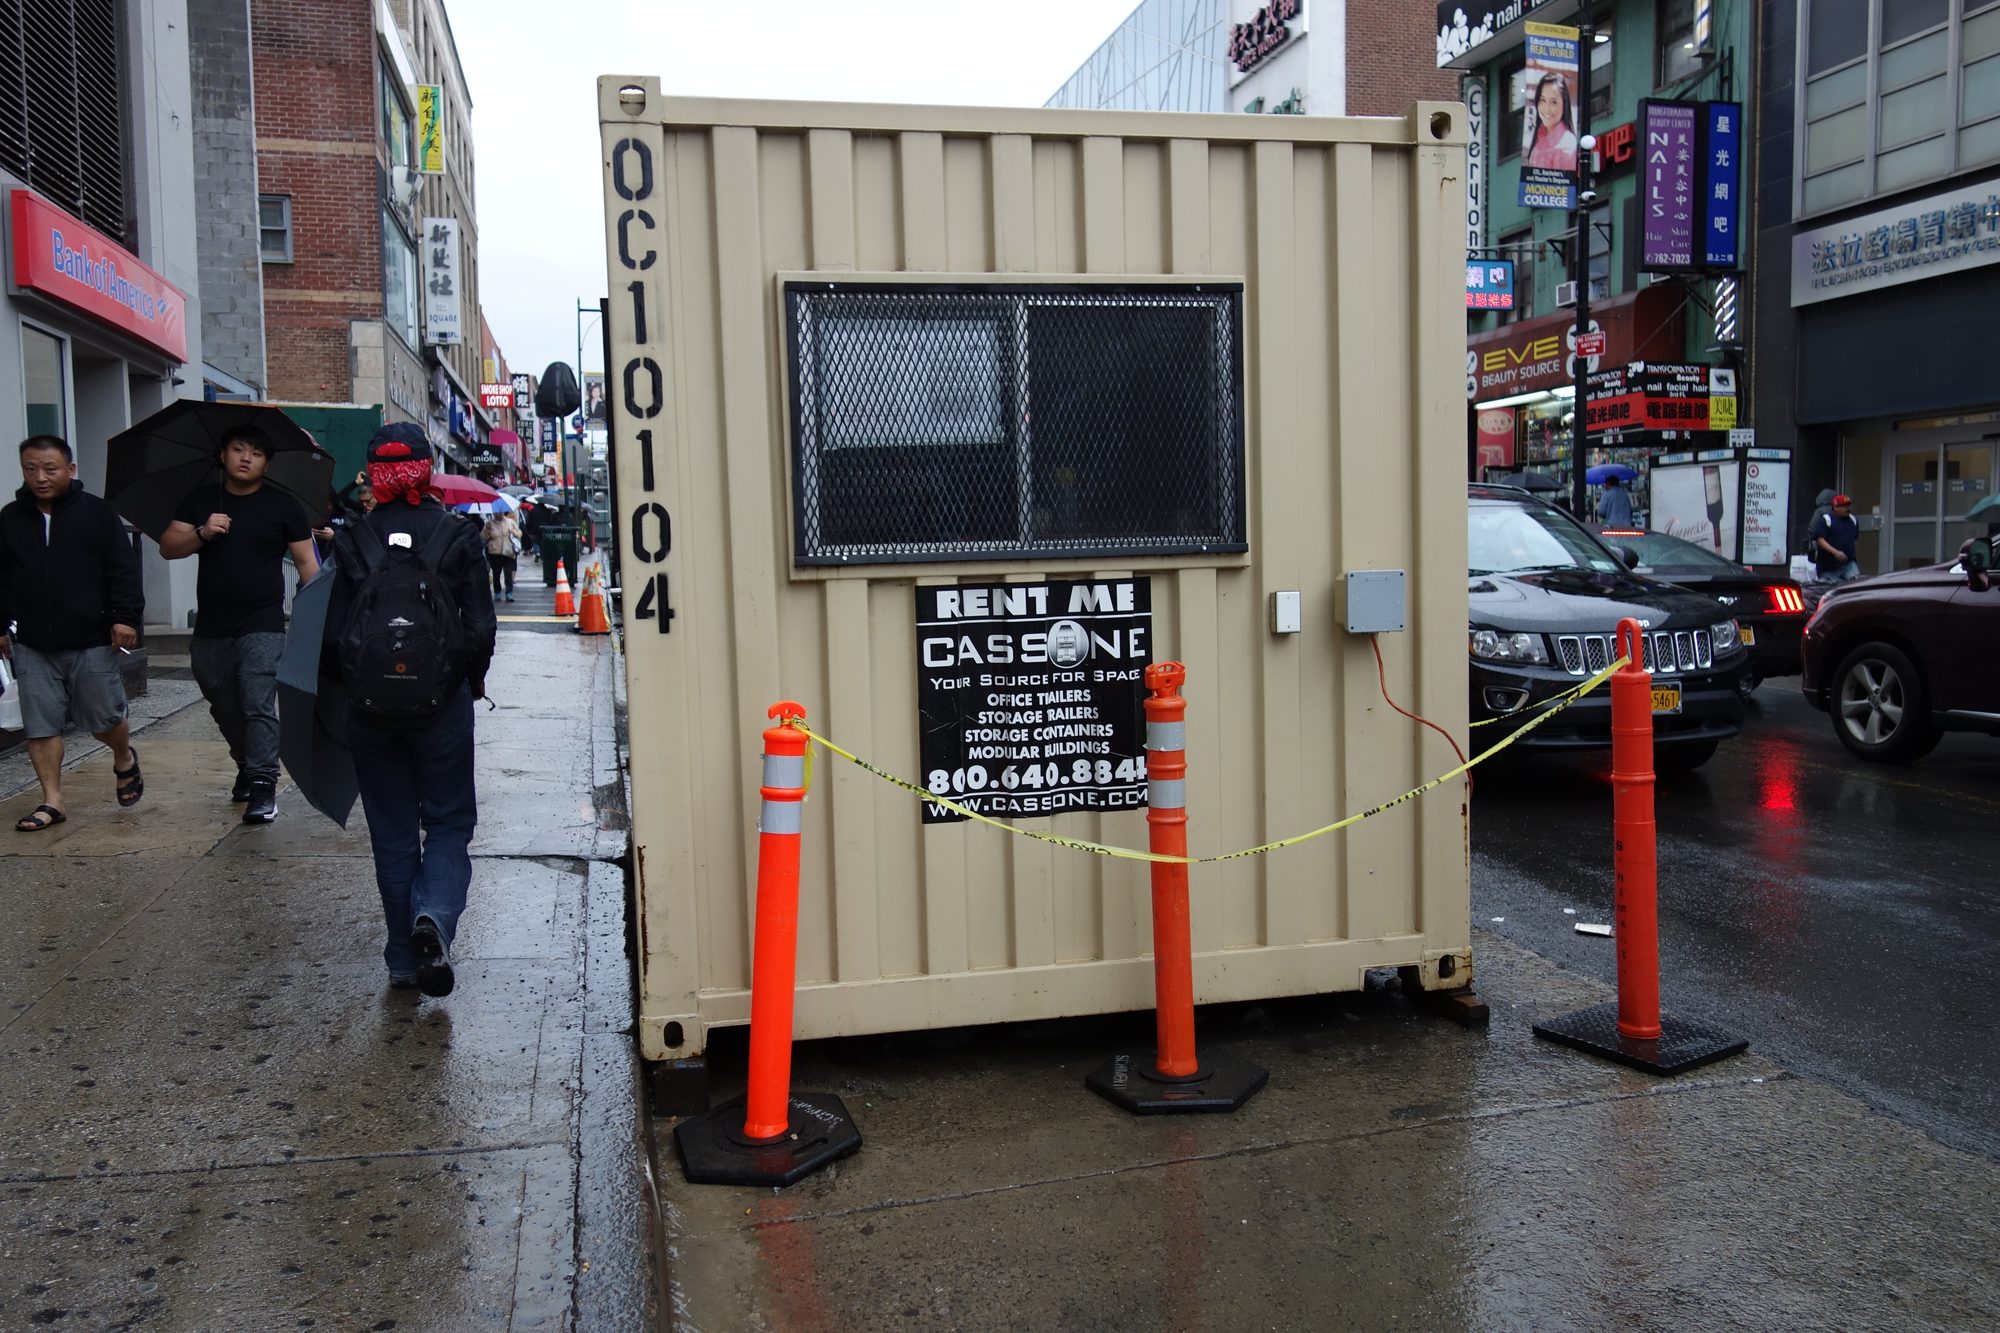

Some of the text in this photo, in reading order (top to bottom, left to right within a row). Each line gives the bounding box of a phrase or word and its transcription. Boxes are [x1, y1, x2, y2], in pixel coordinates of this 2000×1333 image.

[1496, 0, 1522, 29] nail
[1530, 45, 1575, 59] REAL WORLD
[1648, 106, 1694, 117] TRANSFORMATION
[1650, 118, 1692, 128] BEAUTY CENTER
[1649, 132, 1669, 217] NAILS
[1714, 116, 1731, 233] 星光網吧
[1525, 183, 1568, 197] MONROE
[1524, 194, 1568, 207] COLLEGE
[1655, 253, 1690, 264] 762-7023
[52, 228, 155, 321] Bank of America
[429, 314, 457, 323] SQUARE
[1484, 335, 1559, 371] EVE
[1482, 359, 1560, 387] BEAUTY SOURCE
[1647, 365, 1699, 375] TRANSFORMATION
[1677, 374, 1700, 383] Beauty
[481, 385, 512, 394] SMOKE SHOP
[1597, 389, 1613, 399] facial
[1615, 387, 1627, 396] hair
[1647, 383, 1662, 391] nail
[1666, 383, 1688, 391] facial
[1692, 384, 1708, 392] hair
[486, 396, 509, 406] LOTTO
[1668, 454, 1684, 462] TITAN
[1708, 451, 1725, 459] TITAN
[1759, 450, 1779, 458] TITAN
[1747, 482, 1767, 491] Shop
[1747, 491, 1776, 499] without
[1746, 499, 1759, 507] the
[1746, 507, 1773, 517] schlep.
[1745, 516, 1758, 524] We
[1745, 525, 1771, 533] deliver.
[936, 583, 1134, 619] RENT ME
[980, 674, 1048, 687] SOURCE
[1052, 671, 1086, 683] FOR
[987, 693, 1033, 707] OFFICE
[978, 711, 1043, 724] STORAGE
[965, 728, 1029, 742] STORAGE
[969, 746, 1040, 760] MODULAR
